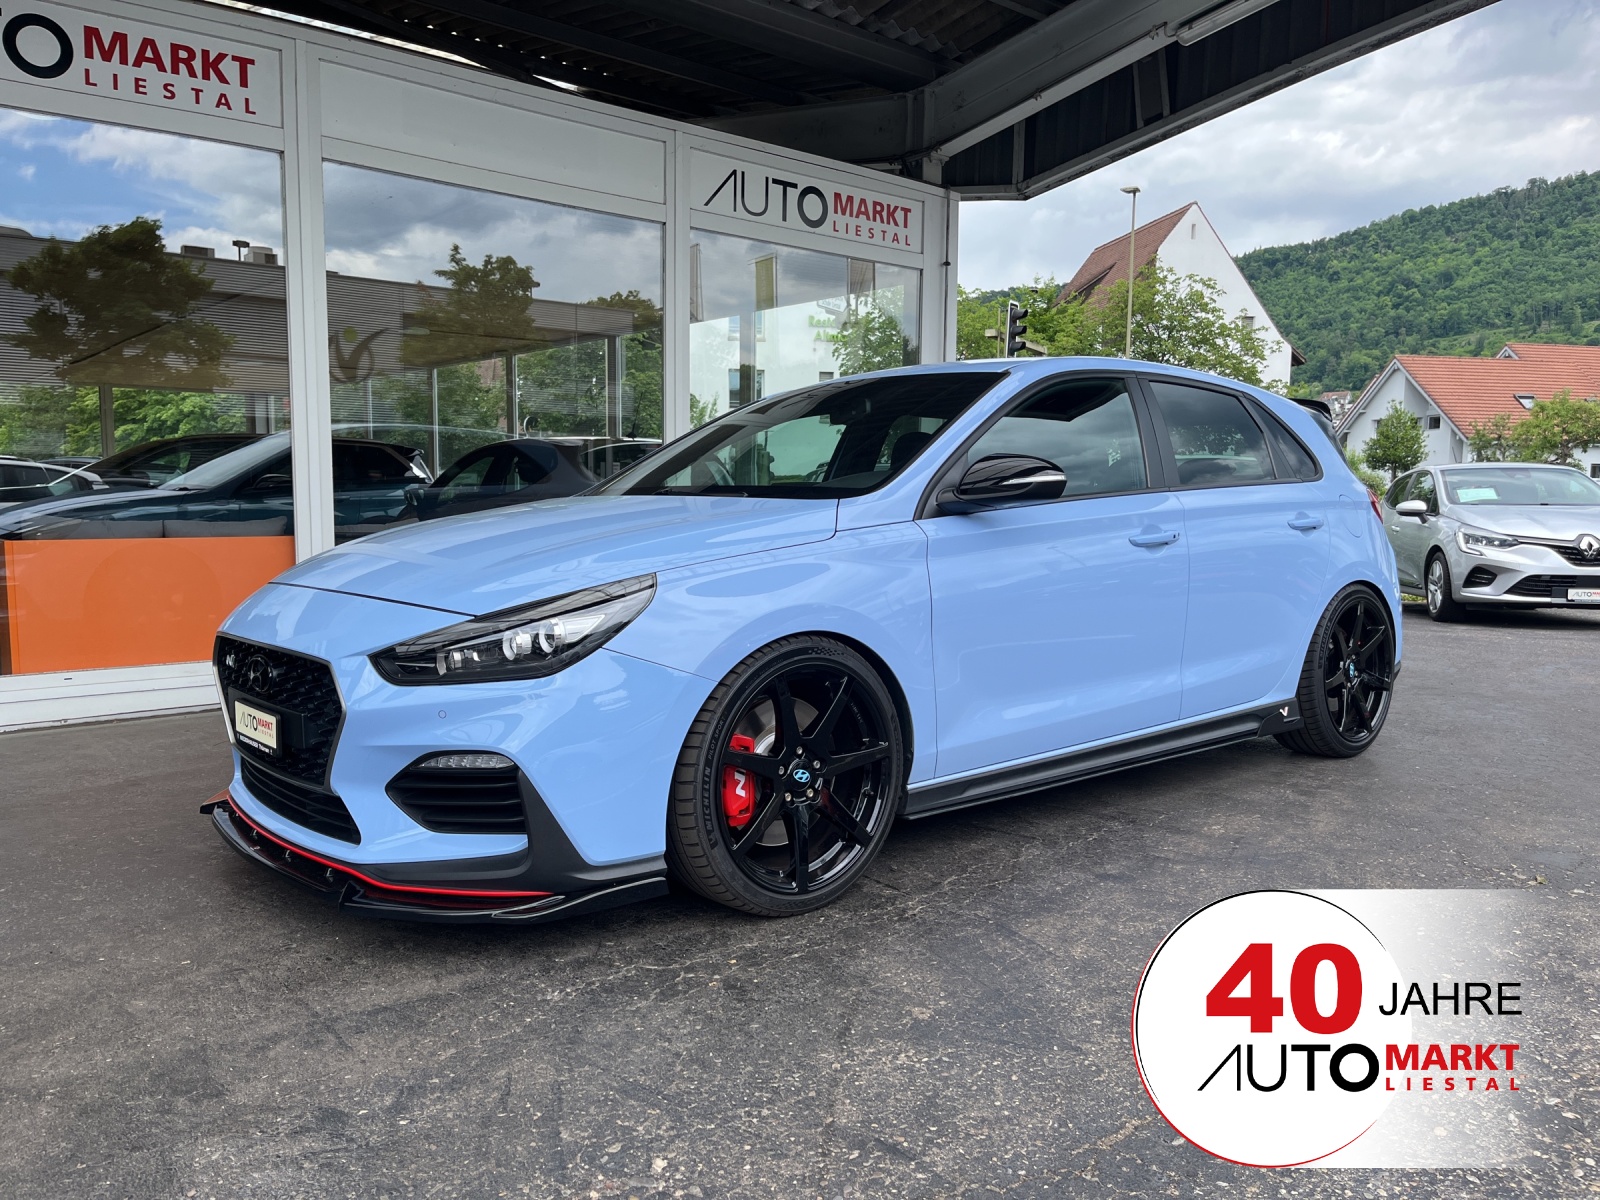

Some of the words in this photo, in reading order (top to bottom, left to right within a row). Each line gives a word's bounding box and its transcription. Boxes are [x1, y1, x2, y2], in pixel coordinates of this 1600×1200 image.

[0, 8, 74, 79] O
[83, 25, 256, 89] MARKT
[84, 68, 257, 116] LIESTAL
[703, 168, 829, 229] AUTO
[833, 191, 912, 229] MARKT
[832, 220, 911, 247] LIESTAL
[240, 711, 258, 732] AUTO
[257, 717, 273, 731] MARKT
[702, 767, 714, 831] MICHELIN
[708, 741, 716, 760] PILOT
[714, 714, 725, 738] SPORT
